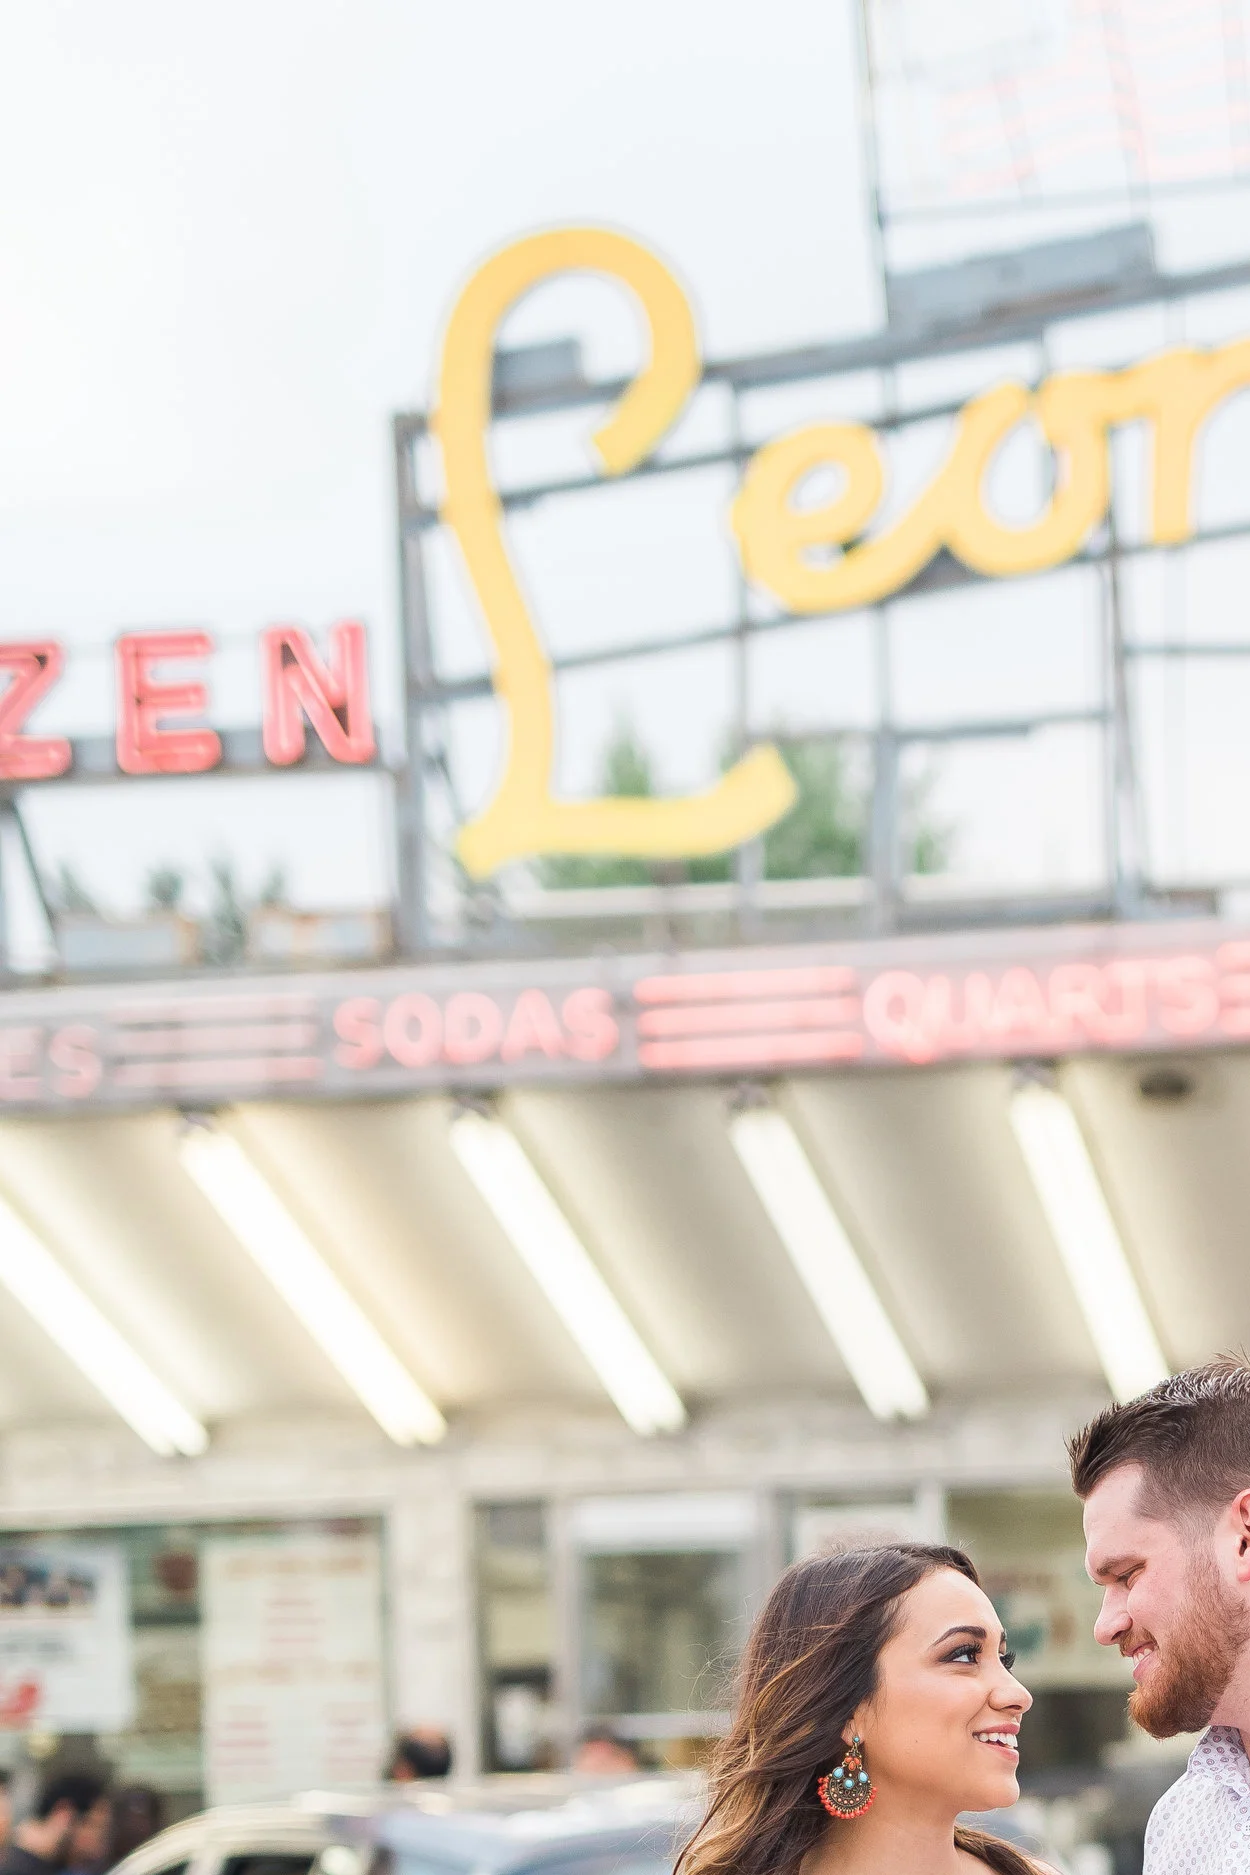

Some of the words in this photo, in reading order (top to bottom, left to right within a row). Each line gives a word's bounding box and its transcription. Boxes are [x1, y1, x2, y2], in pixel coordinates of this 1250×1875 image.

[0, 619, 379, 780] ZEN
[332, 985, 621, 1071] SODAS
[861, 954, 1221, 1064] QUARTS
